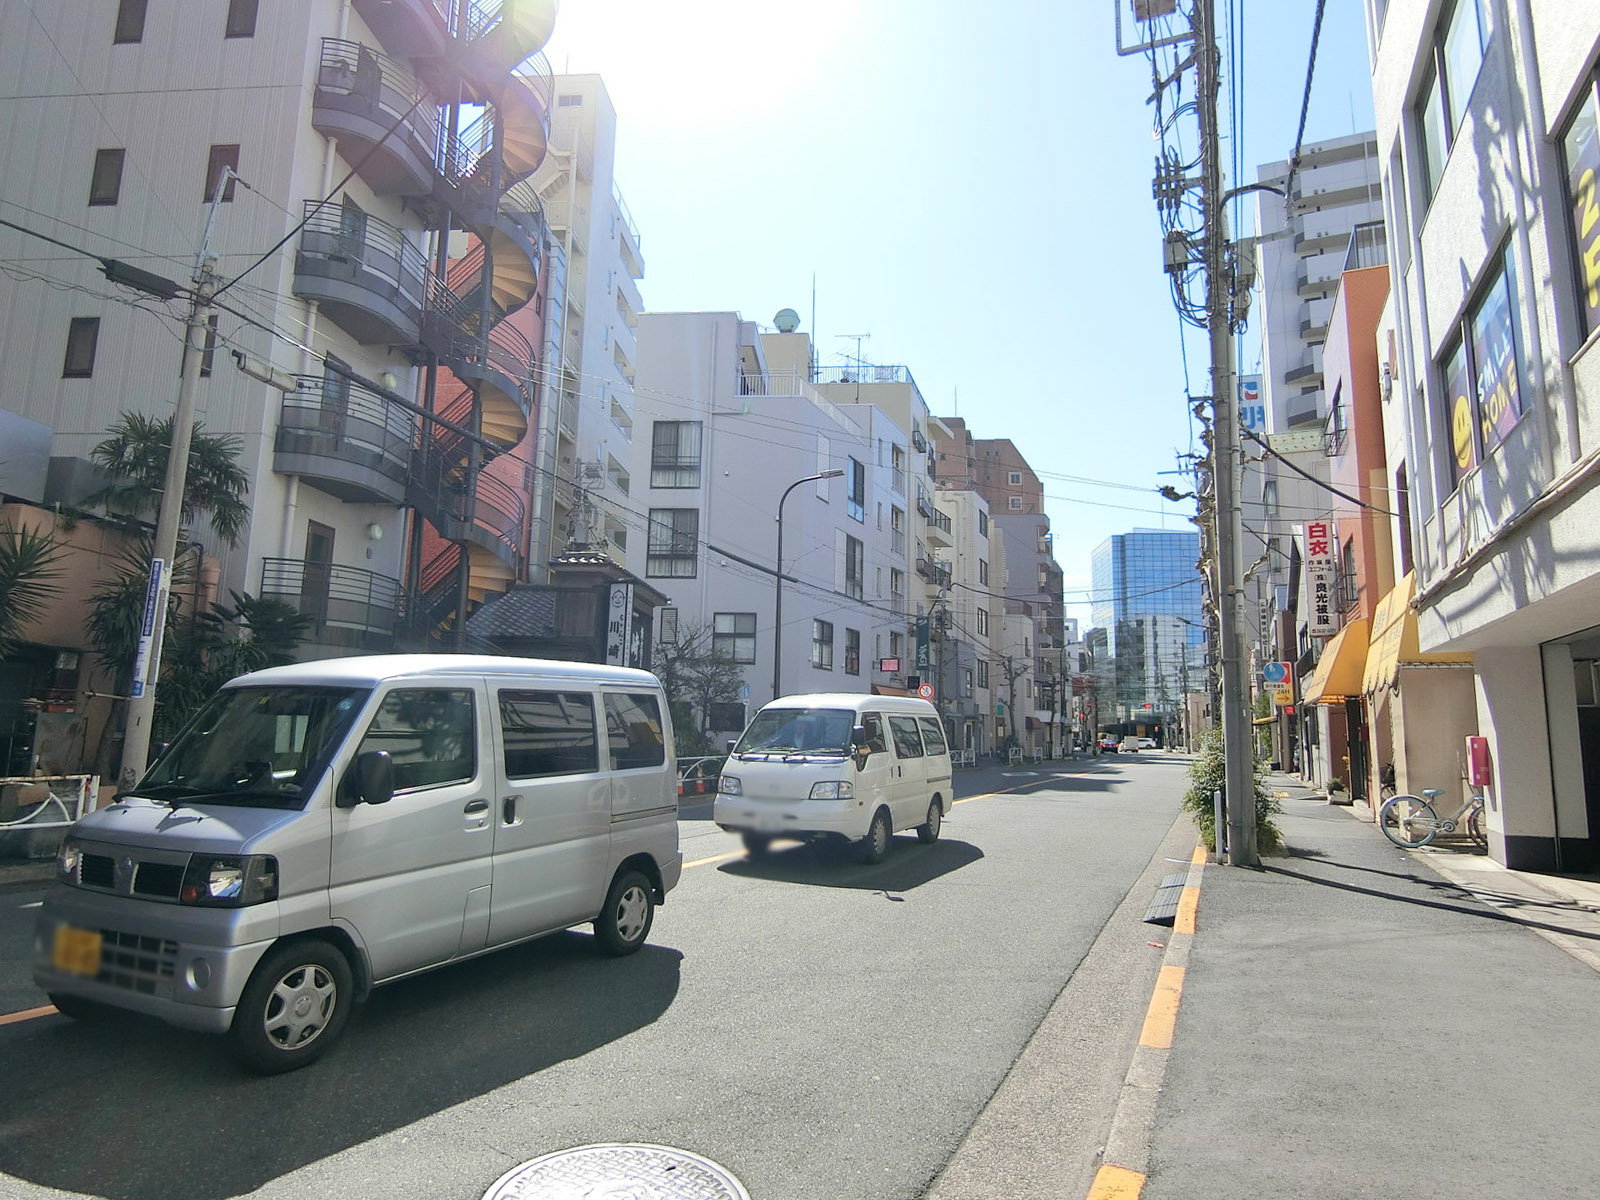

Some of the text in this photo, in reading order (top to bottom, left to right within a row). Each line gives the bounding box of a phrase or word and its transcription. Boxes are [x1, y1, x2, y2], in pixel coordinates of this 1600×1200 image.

[1482, 358, 1518, 444] HOME
[1308, 522, 1328, 556] 白衣
[609, 621, 620, 659] 川崎
